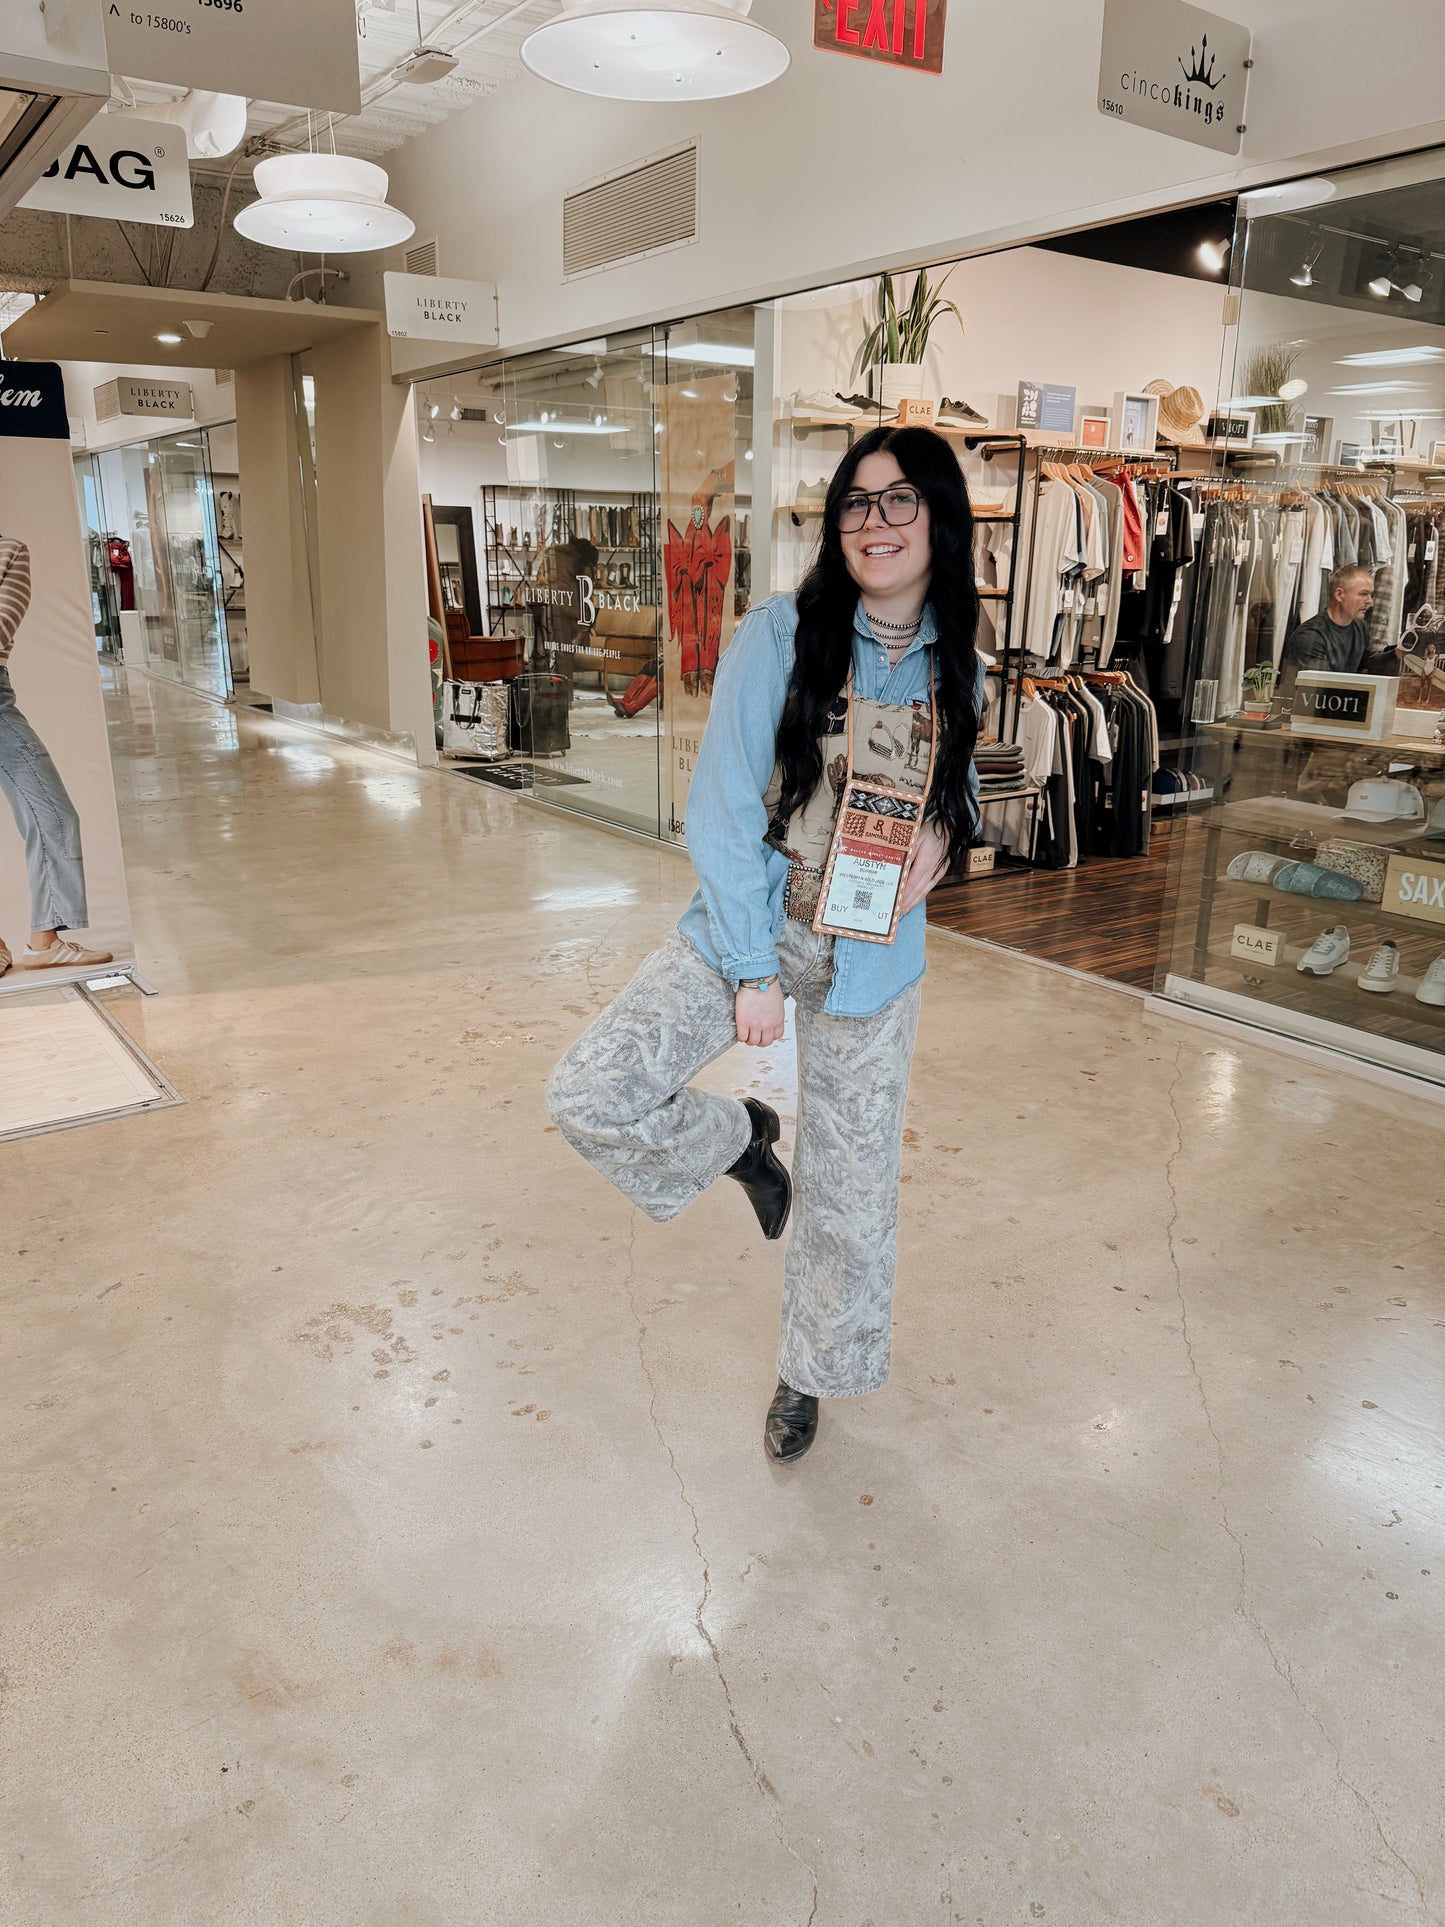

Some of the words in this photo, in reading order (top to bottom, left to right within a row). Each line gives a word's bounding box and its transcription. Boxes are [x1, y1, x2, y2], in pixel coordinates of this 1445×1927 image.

[130, 12, 143, 25] to
[147, 14, 191, 35] 15800's
[1102, 98, 1124, 115] 15610
[159, 212, 186, 224] 15626
[416, 297, 468, 312] LIBERTY
[424, 310, 462, 323] BLACK
[130, 387, 181, 399] LIBERTY
[138, 399, 176, 409] BLACK
[909, 405, 932, 415] CLAE
[525, 587, 574, 607] LIBERTY
[598, 593, 641, 613] BLACK
[672, 736, 699, 755] LIBE
[972, 854, 993, 863] CLAE
[1399, 872, 1445, 909] SAX
[830, 903, 849, 913] BUY
[877, 911, 889, 921] UT
[1237, 935, 1273, 952] CLAE
